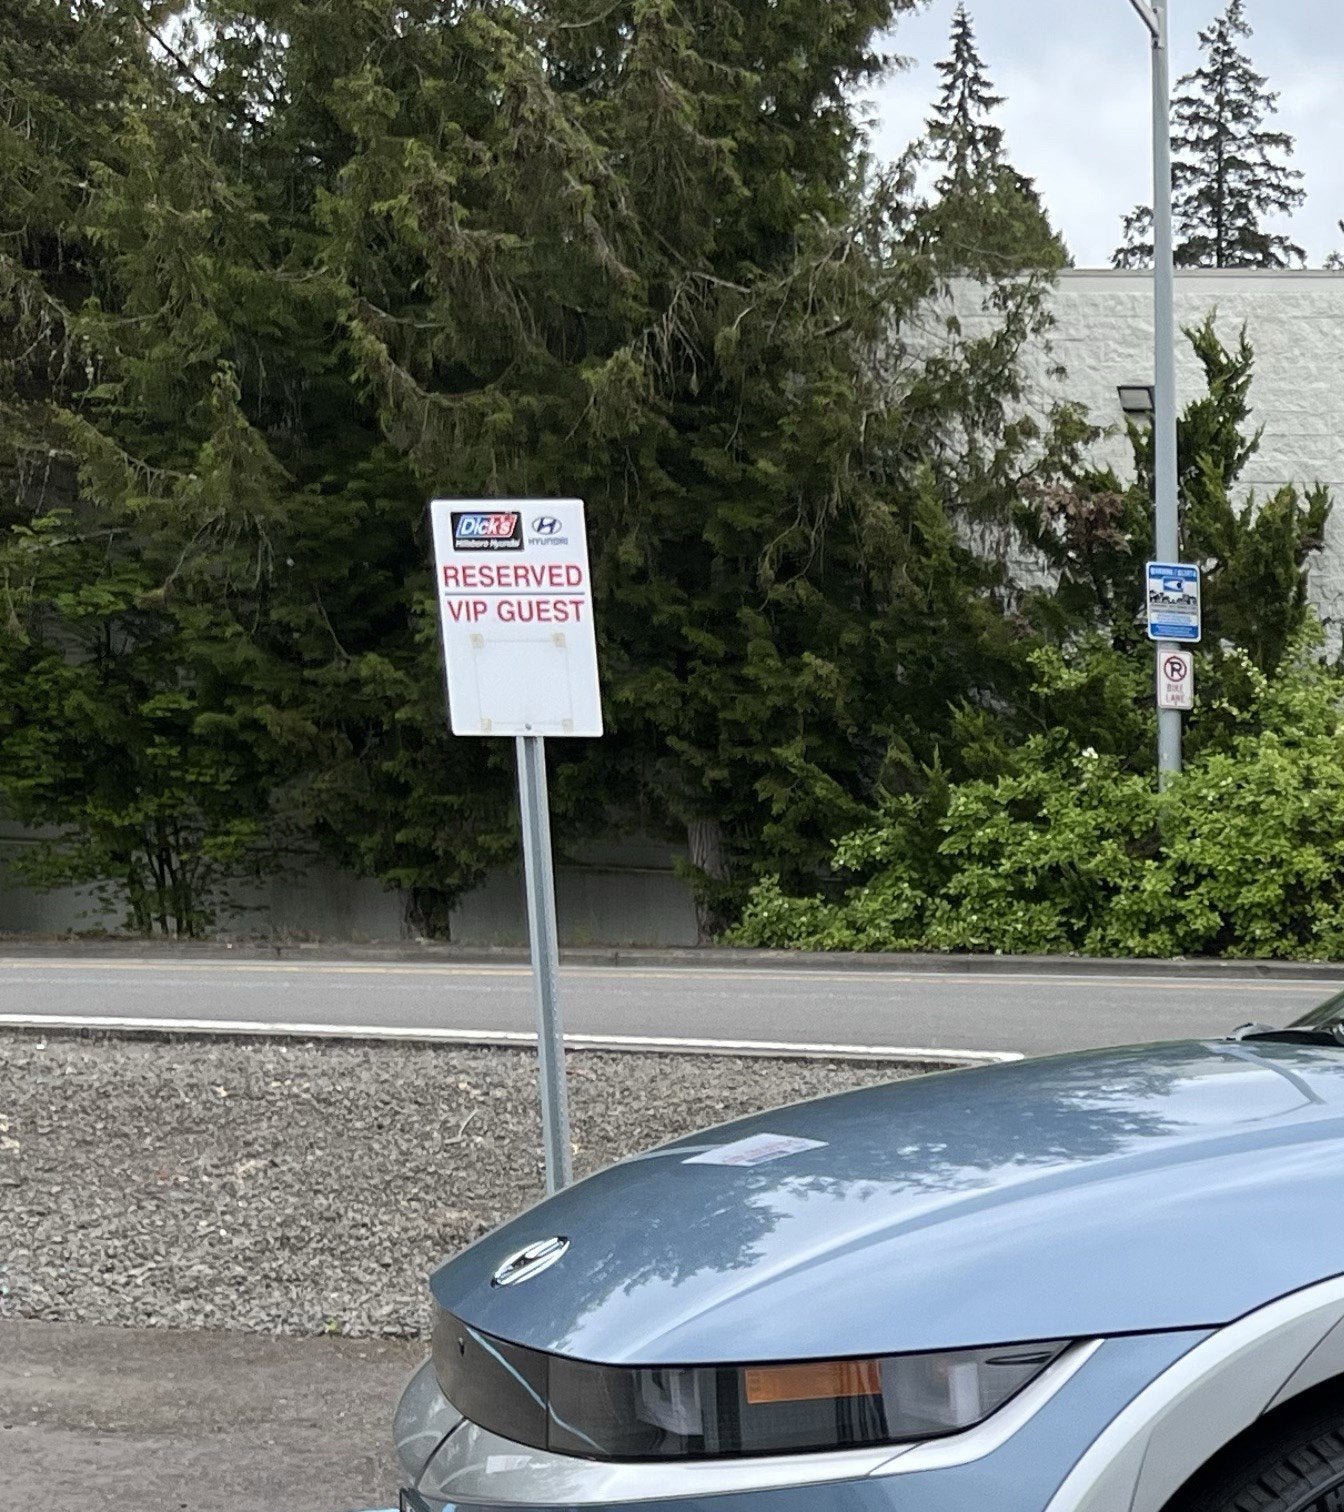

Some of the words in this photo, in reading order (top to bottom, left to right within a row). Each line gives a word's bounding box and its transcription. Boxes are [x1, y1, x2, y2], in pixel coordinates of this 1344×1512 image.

[460, 514, 513, 536] Dick's
[528, 537, 569, 546] HYUNDAI
[443, 565, 584, 588] RESERVED
[448, 600, 488, 622] VIP
[497, 599, 585, 623] GUEST
